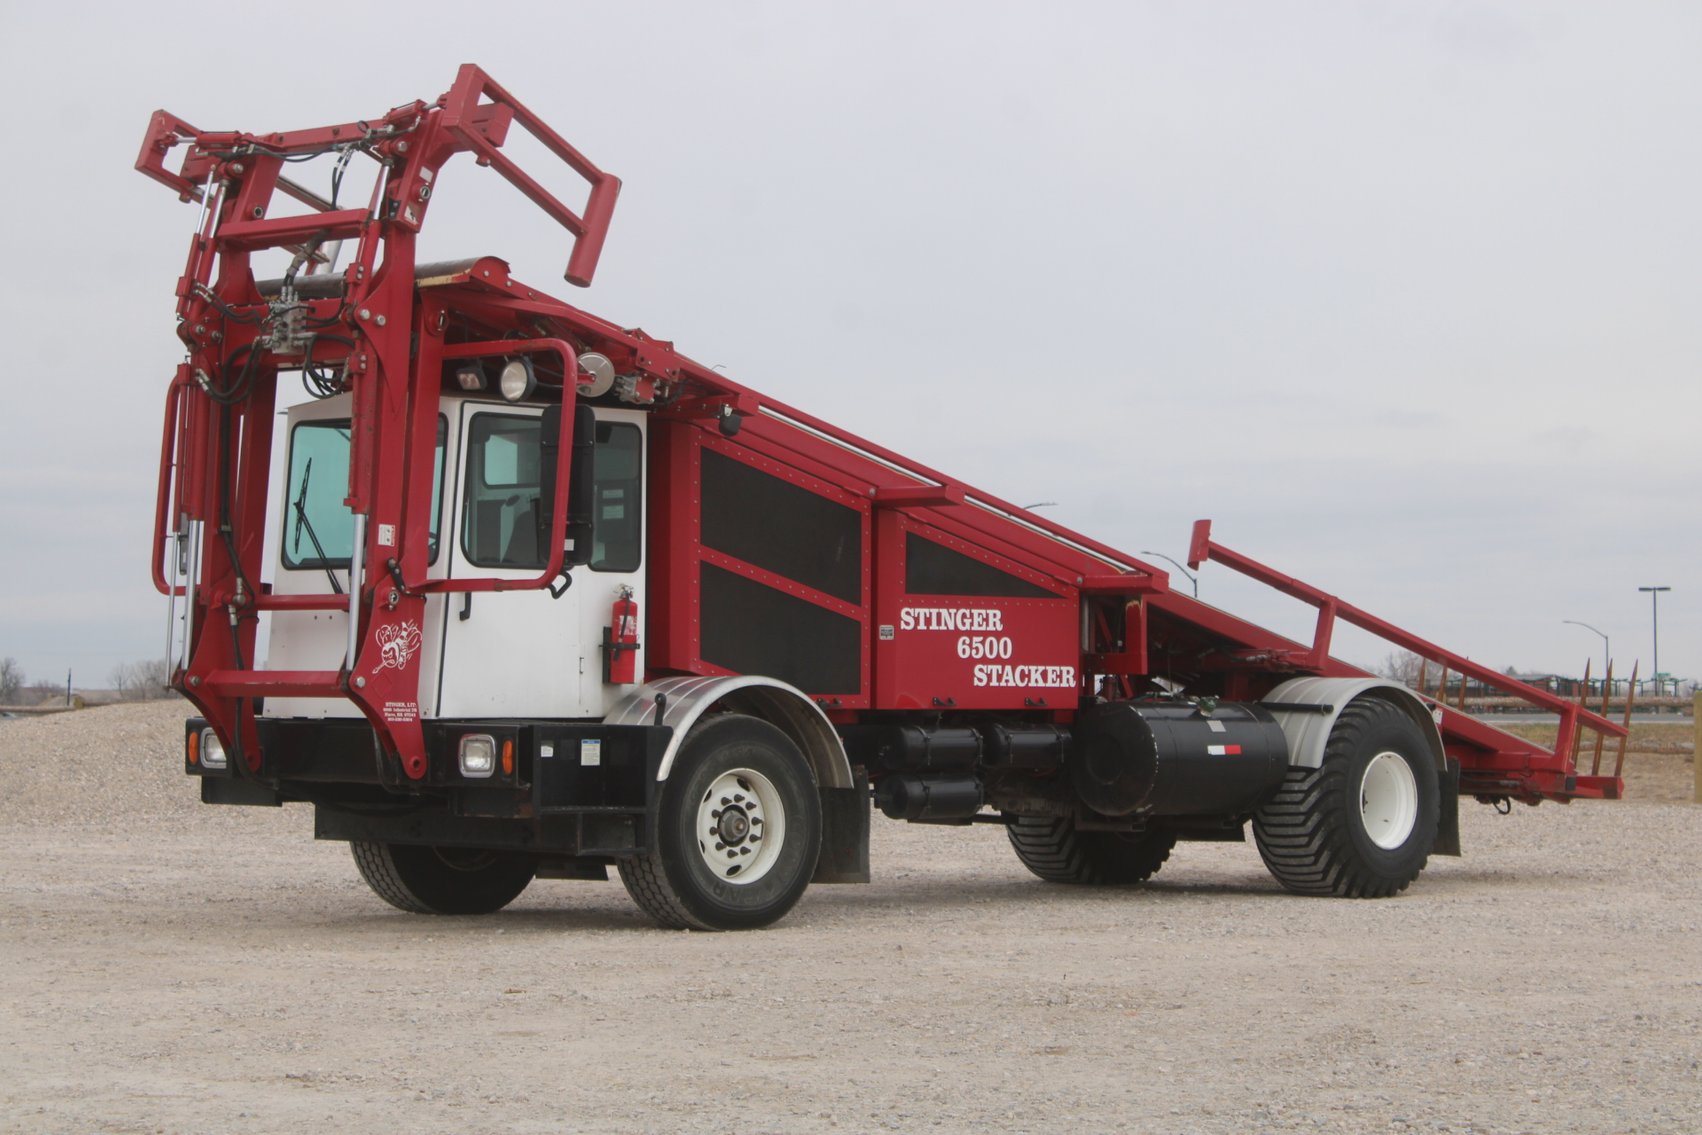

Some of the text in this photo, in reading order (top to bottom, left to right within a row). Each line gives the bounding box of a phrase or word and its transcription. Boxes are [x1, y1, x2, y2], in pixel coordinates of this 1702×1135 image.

[900, 607, 1003, 631] STINGER
[957, 636, 1012, 659] 6500
[973, 664, 1076, 687] STACKER
